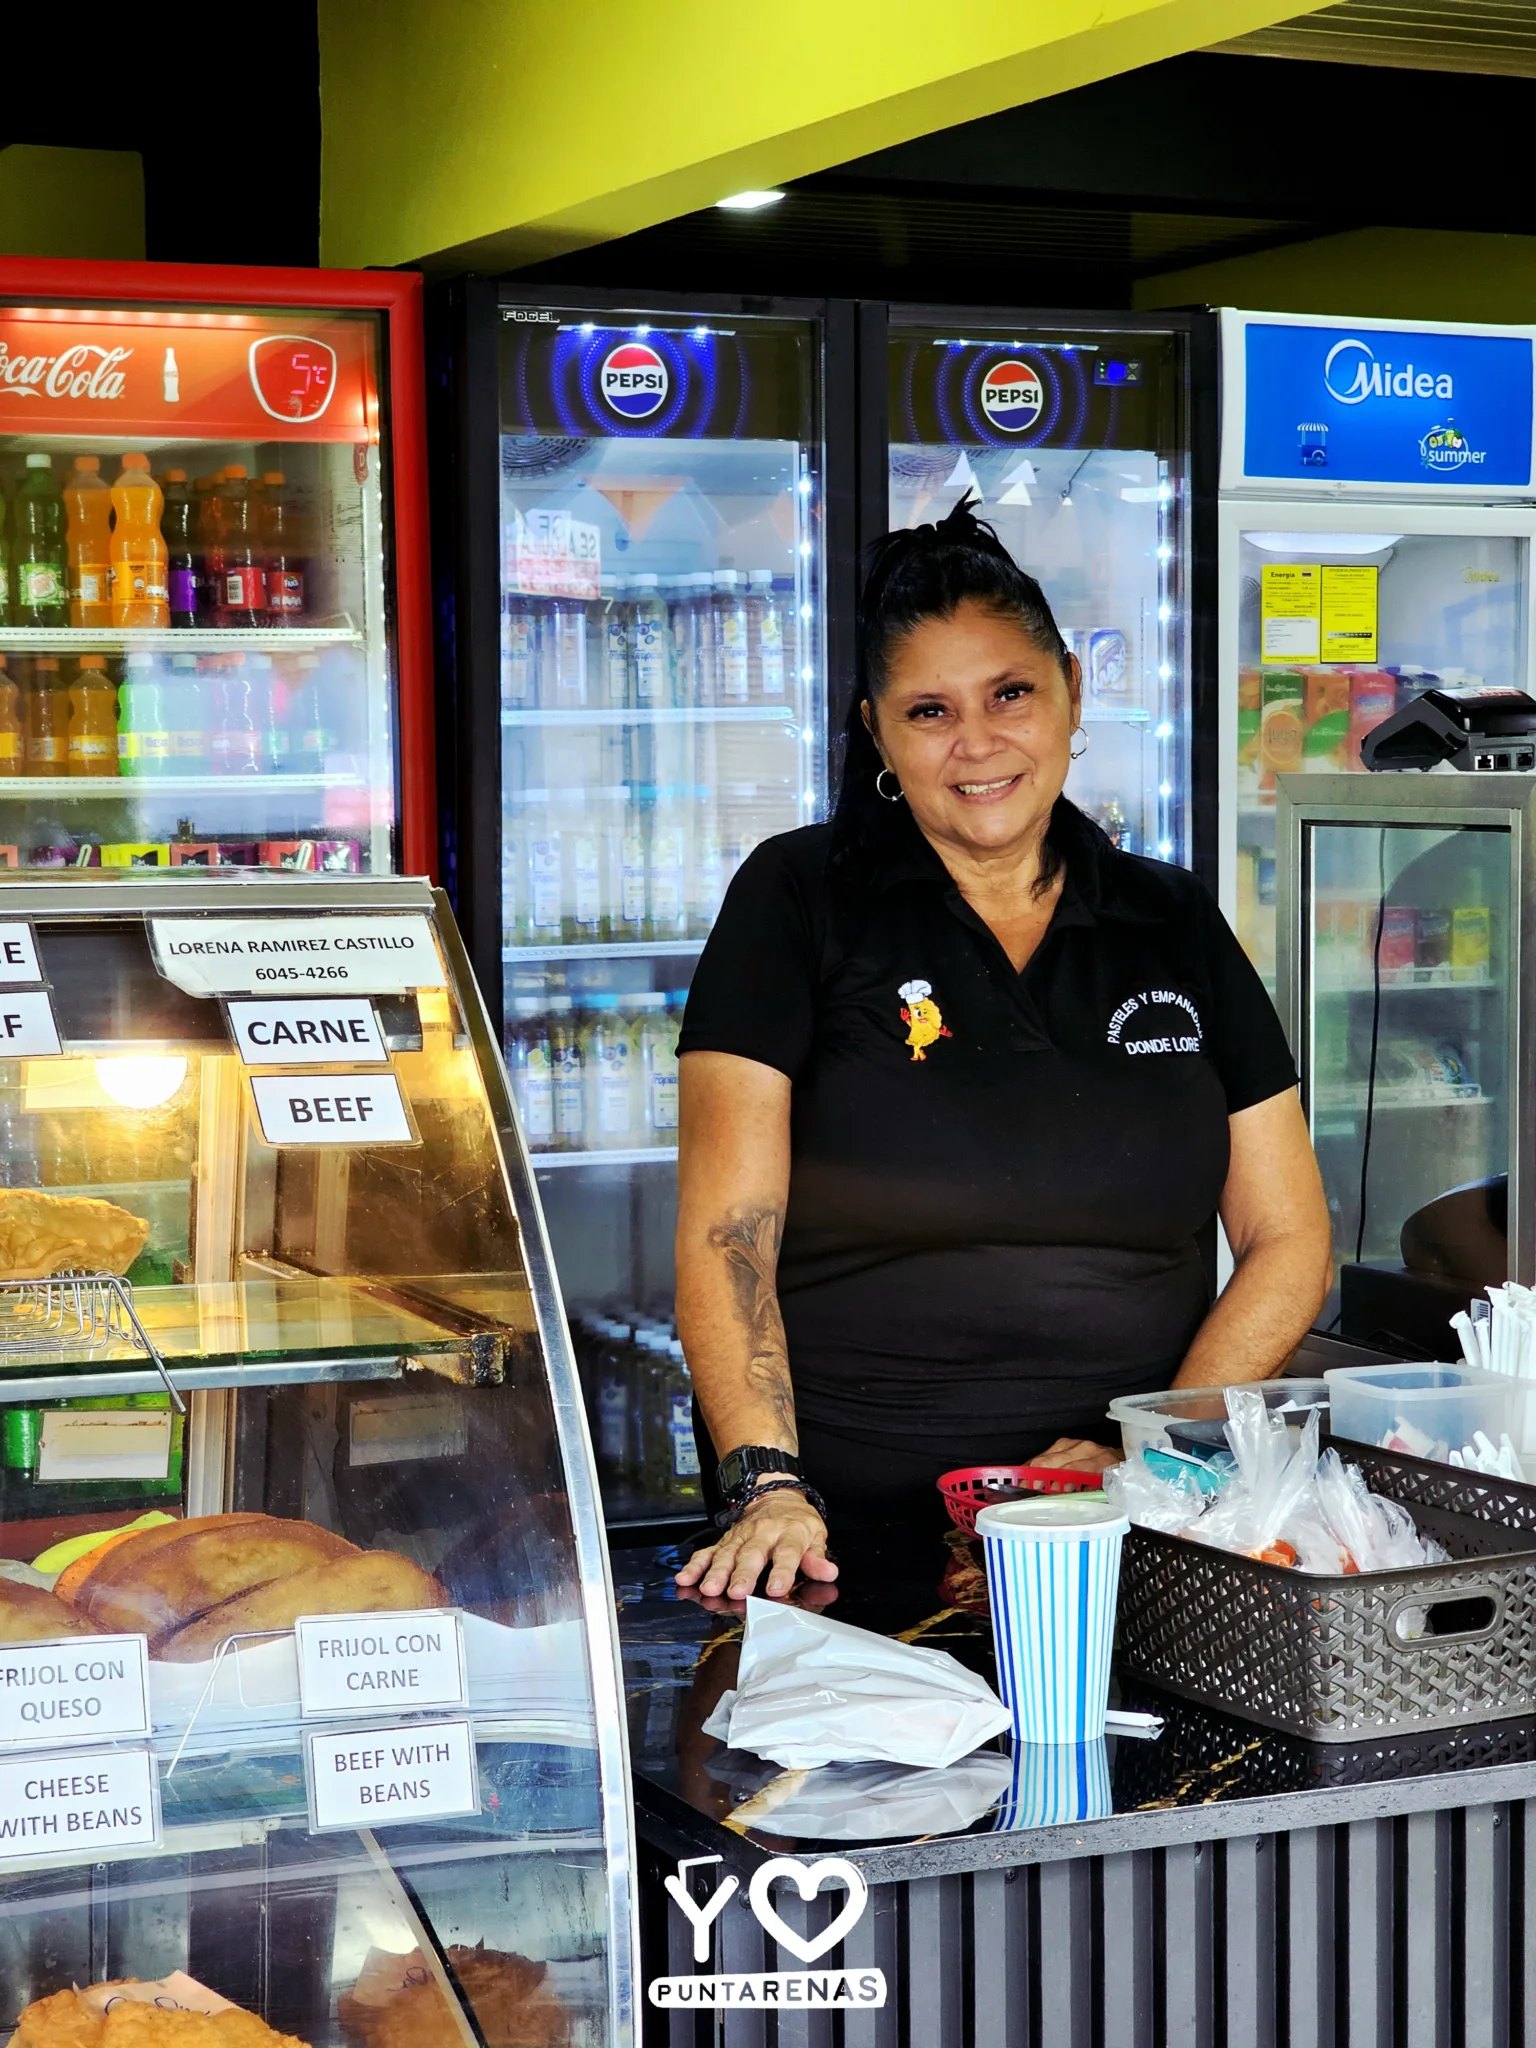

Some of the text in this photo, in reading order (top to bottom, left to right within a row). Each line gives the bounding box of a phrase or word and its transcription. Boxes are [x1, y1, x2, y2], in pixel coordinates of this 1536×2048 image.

[503, 310, 560, 323] FOGEL
[0, 342, 134, 400] oca-Cola
[606, 372, 663, 390] PEPSI
[1330, 350, 1453, 402] Midea
[985, 388, 1038, 404] PEPSI
[1428, 449, 1486, 464] summer
[169, 936, 415, 956] LORENA RAMIREZ CASTILLO
[255, 965, 349, 981] 6045-4266
[1106, 998, 1139, 1044] PASTELES
[1138, 992, 1148, 1005] Y
[247, 1018, 371, 1046] CARNE
[1124, 1036, 1200, 1055] DONDE LORE
[288, 1096, 374, 1123] BEEF
[318, 1633, 442, 1659] FRIJOL CON
[74, 1660, 124, 1682] CON
[346, 1668, 420, 1691] CARNE
[20, 1697, 102, 1724] QUESO
[334, 1743, 451, 1773] BEEF WITH
[24, 1774, 110, 1800] CHEESE
[360, 1780, 431, 1804] BEANS
[67, 1806, 142, 1832] BEANS
